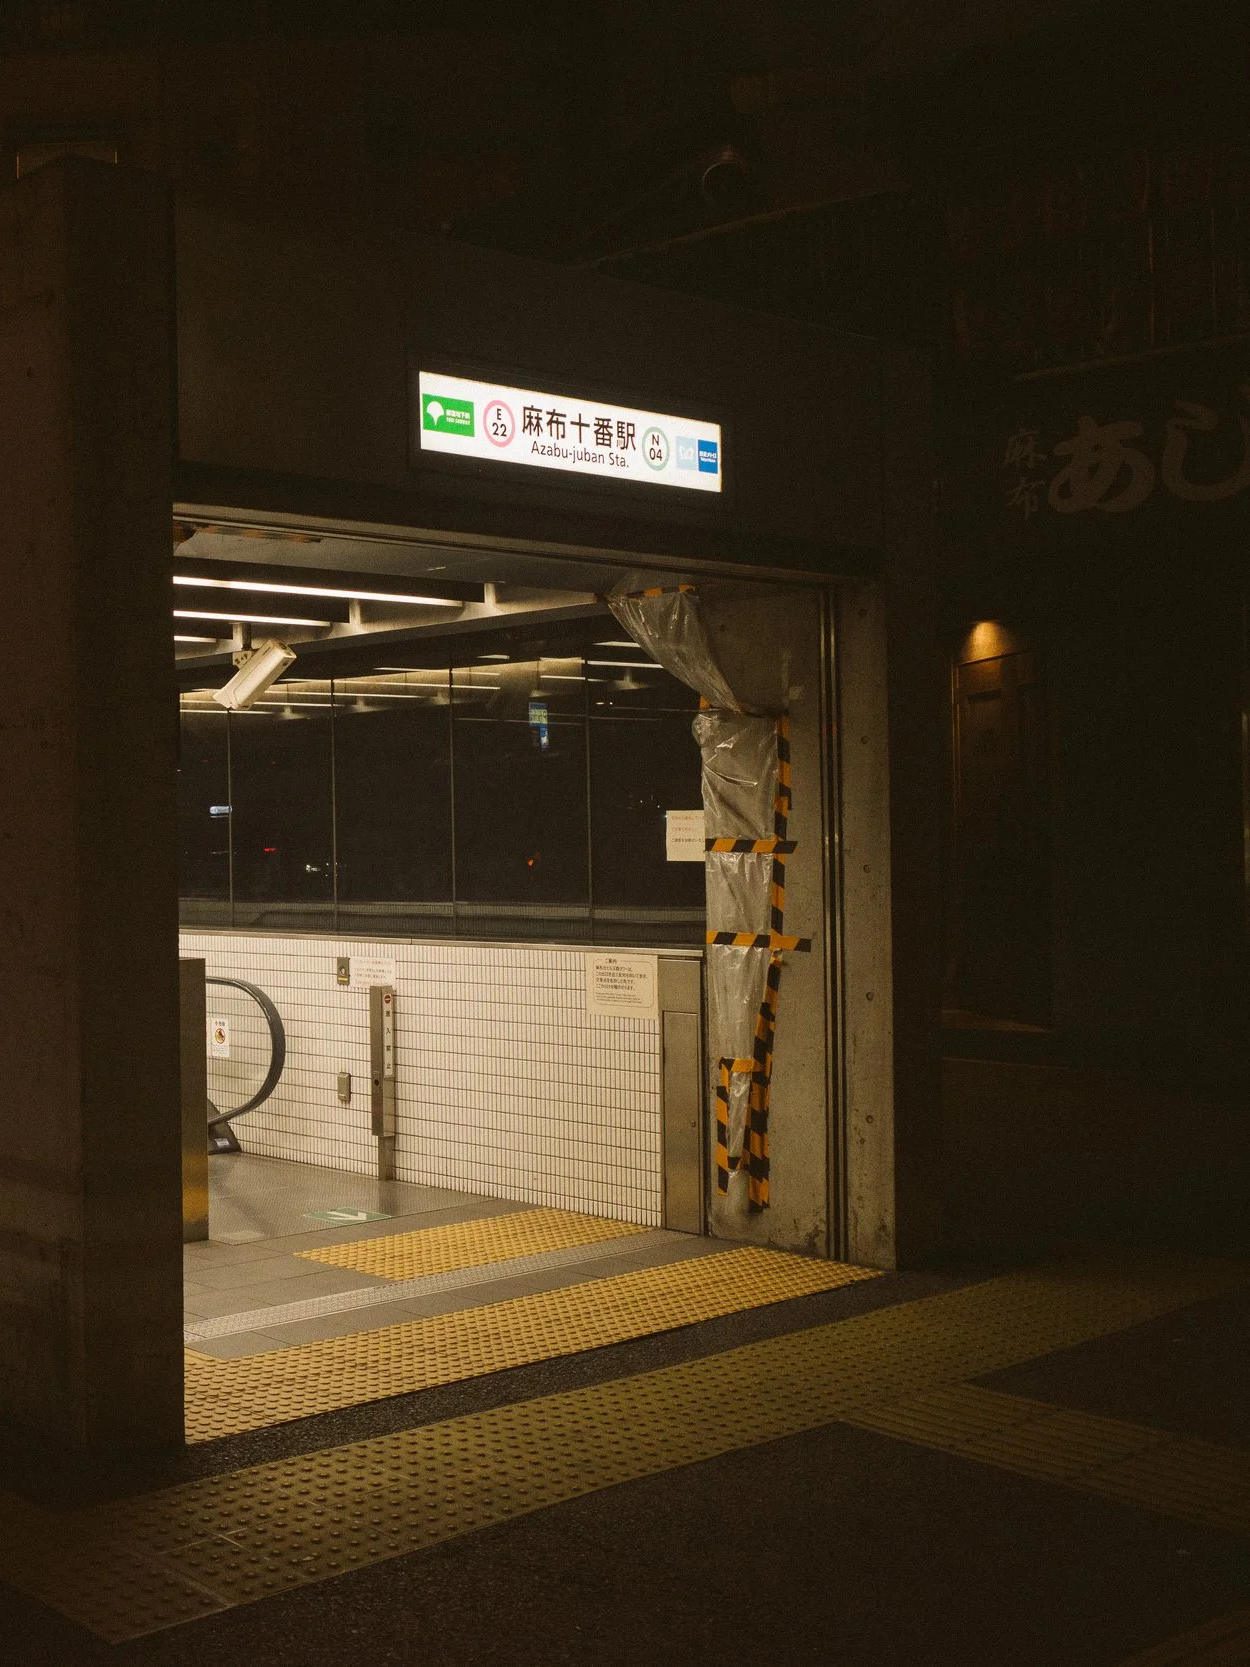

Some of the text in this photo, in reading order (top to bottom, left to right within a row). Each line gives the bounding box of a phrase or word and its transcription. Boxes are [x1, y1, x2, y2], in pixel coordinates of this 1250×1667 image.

[496, 408, 502, 421] E
[492, 422, 507, 437] 22
[522, 404, 637, 451] 麻布十番駅
[652, 434, 660, 446] N
[531, 440, 630, 468] Azabu-juban Sta.
[649, 447, 663, 461] 04
